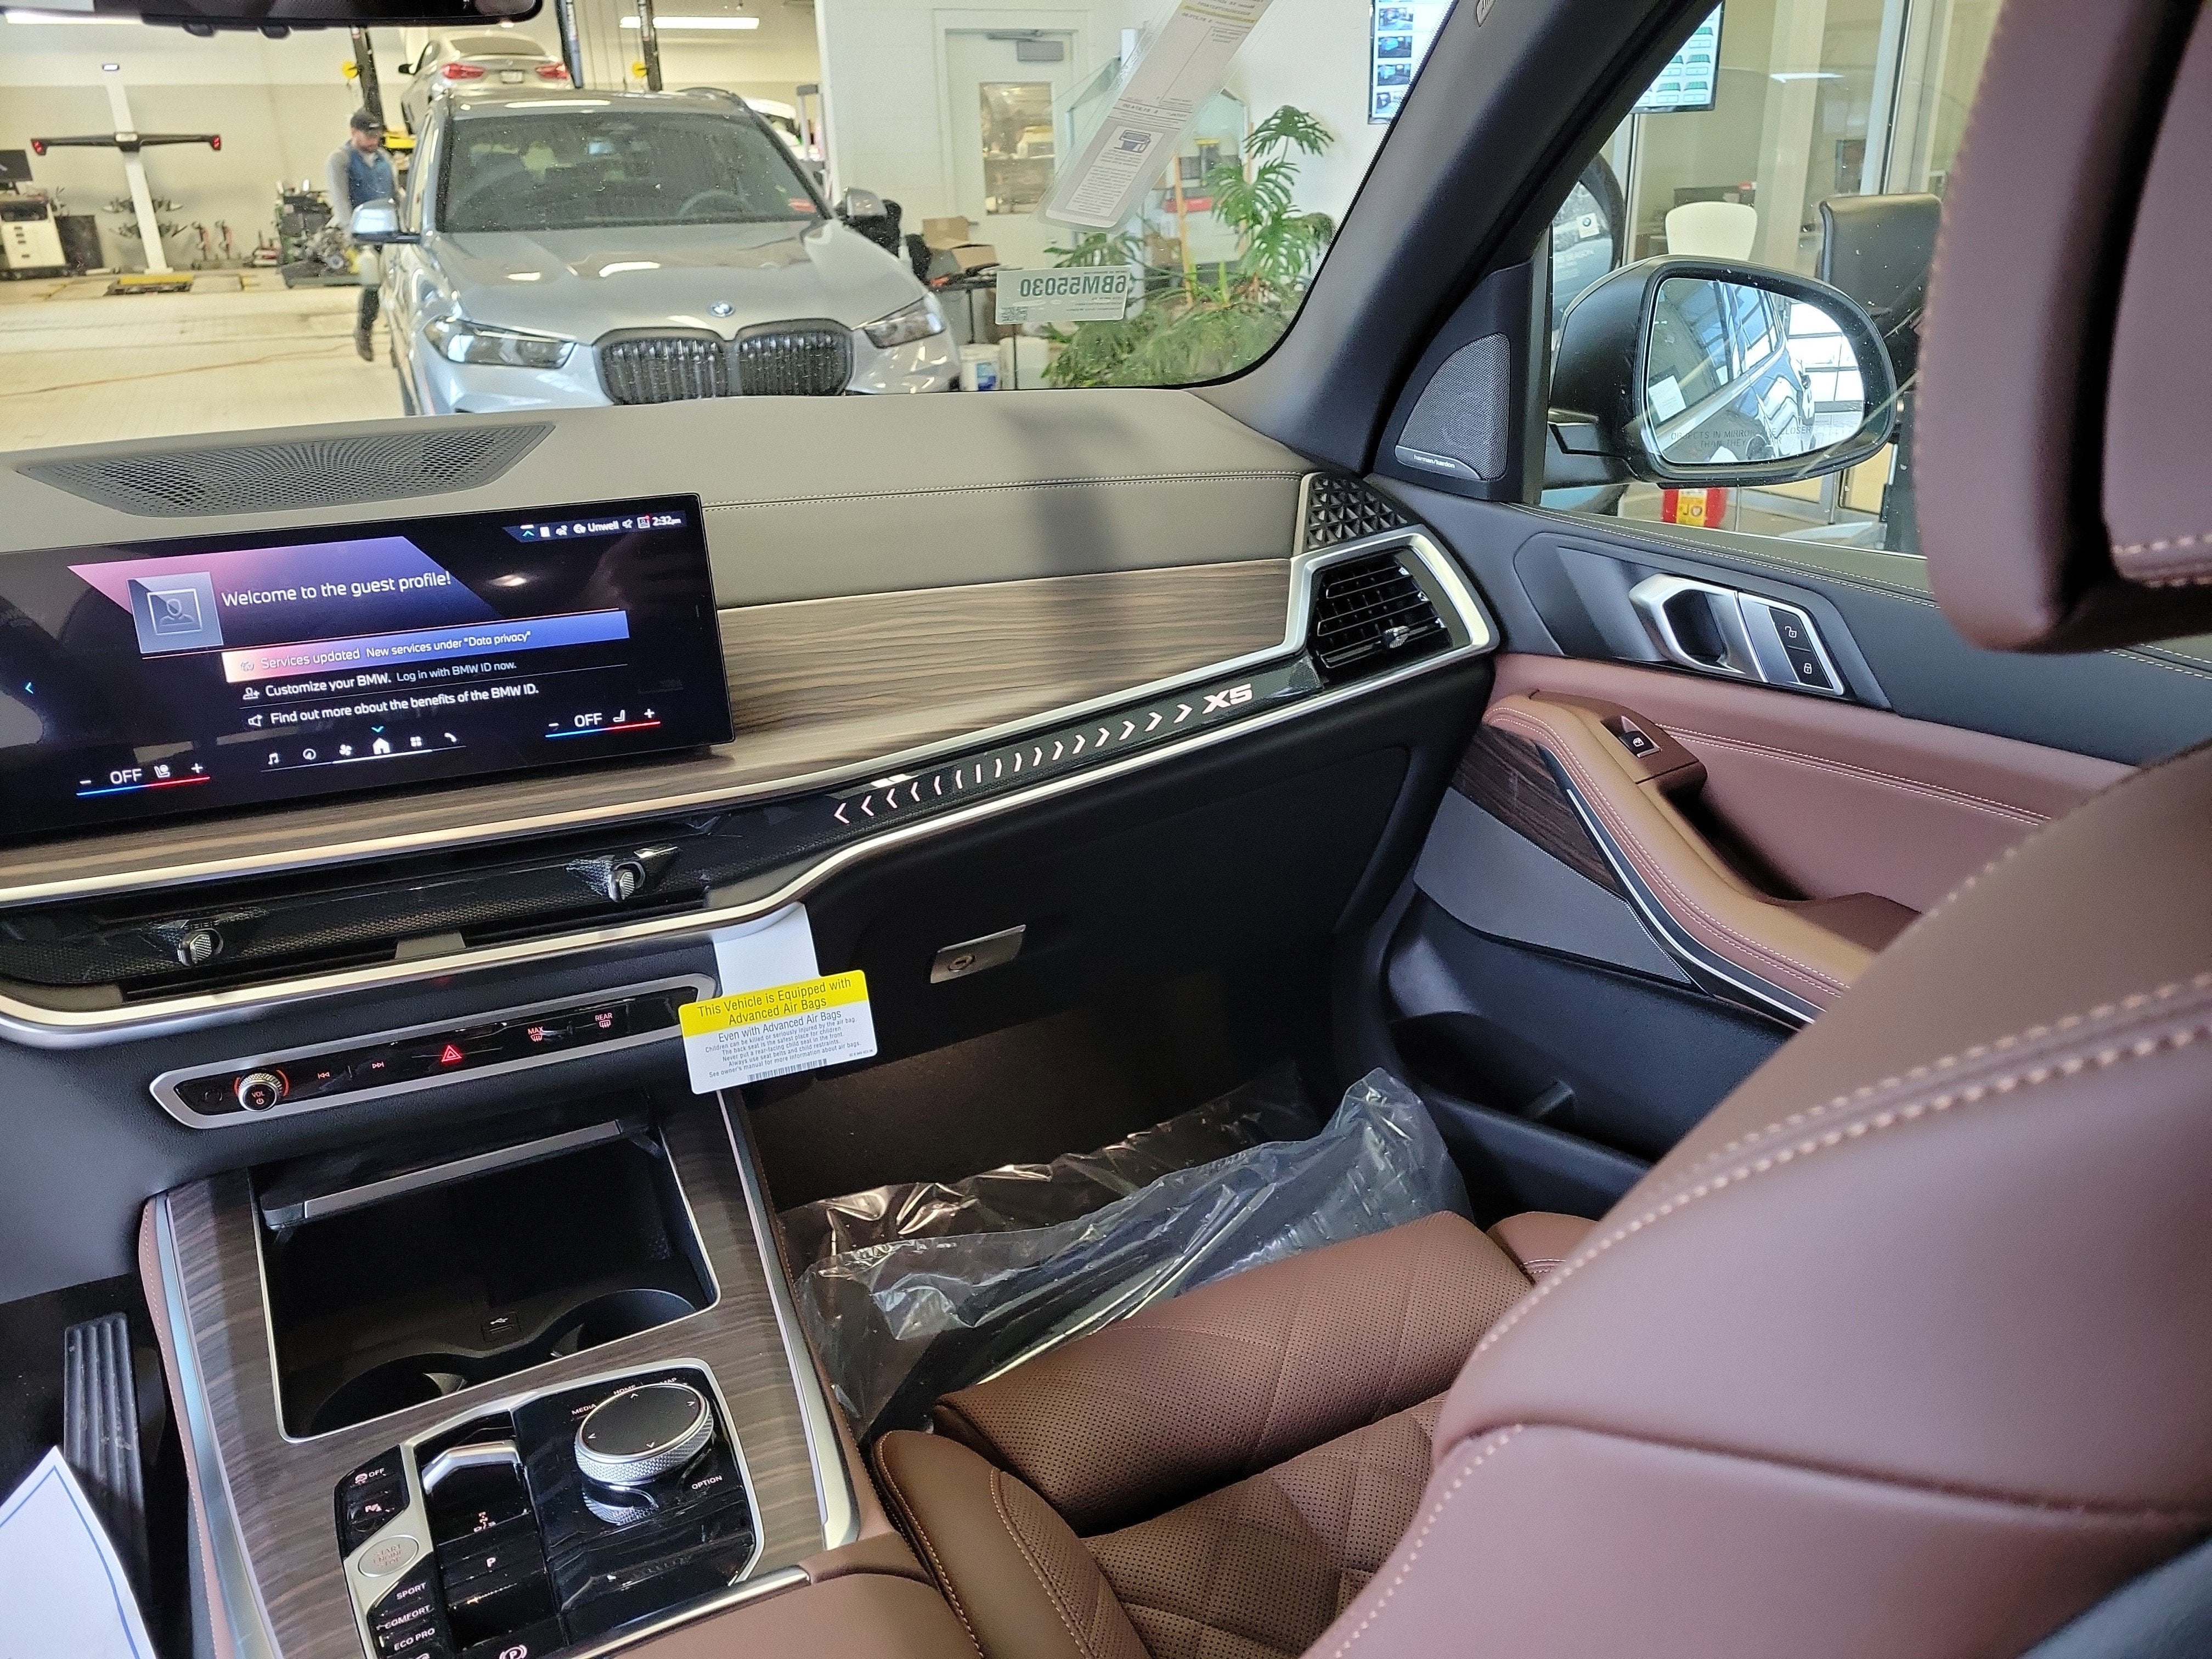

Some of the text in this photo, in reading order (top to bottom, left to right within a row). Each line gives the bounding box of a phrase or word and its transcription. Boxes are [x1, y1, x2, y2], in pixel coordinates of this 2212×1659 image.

[1413, 454, 1455, 469] harman/kardon
[587, 520, 619, 532] Unwell
[221, 571, 451, 606] Welcome to the guest profile!
[261, 631, 531, 670] Services updated New services under "Data privacy"
[265, 661, 517, 697] Customize your BMW. Log in with BMW ID now.
[270, 683, 539, 724] Find out more about the benefits of the BMW ID.
[1201, 683, 1252, 714] X5
[574, 713, 602, 728] OFF
[110, 768, 143, 786] OFF
[697, 978, 851, 1017] This Vehicle is Equipped with
[595, 1012, 613, 1022] REAR
[729, 998, 827, 1025] Advanced Air Bags
[528, 1026, 543, 1035] MAX
[718, 1011, 842, 1042] Even with Advanced Air Bags
[820, 1026, 843, 1035] children.
[705, 1044, 729, 1053] Children
[773, 1029, 797, 1039] seriously
[799, 1024, 817, 1033] injured
[814, 1039, 841, 1048] restraints.
[723, 1054, 738, 1062] Never
[755, 1044, 785, 1054] rear-facing
[786, 1040, 799, 1048] child
[721, 1065, 742, 1075] owner's
[743, 1061, 763, 1070] manual
[789, 1049, 820, 1060] information
[613, 1384, 636, 1396] HOME
[571, 1403, 597, 1415] MEDIA
[369, 1468, 385, 1477] OFF
[691, 1475, 723, 1489] OPTION
[487, 1558, 496, 1567] P
[396, 1582, 426, 1600] SPORT
[385, 1604, 431, 1629] COMFORT
[394, 1628, 436, 1651] ECO PRO
